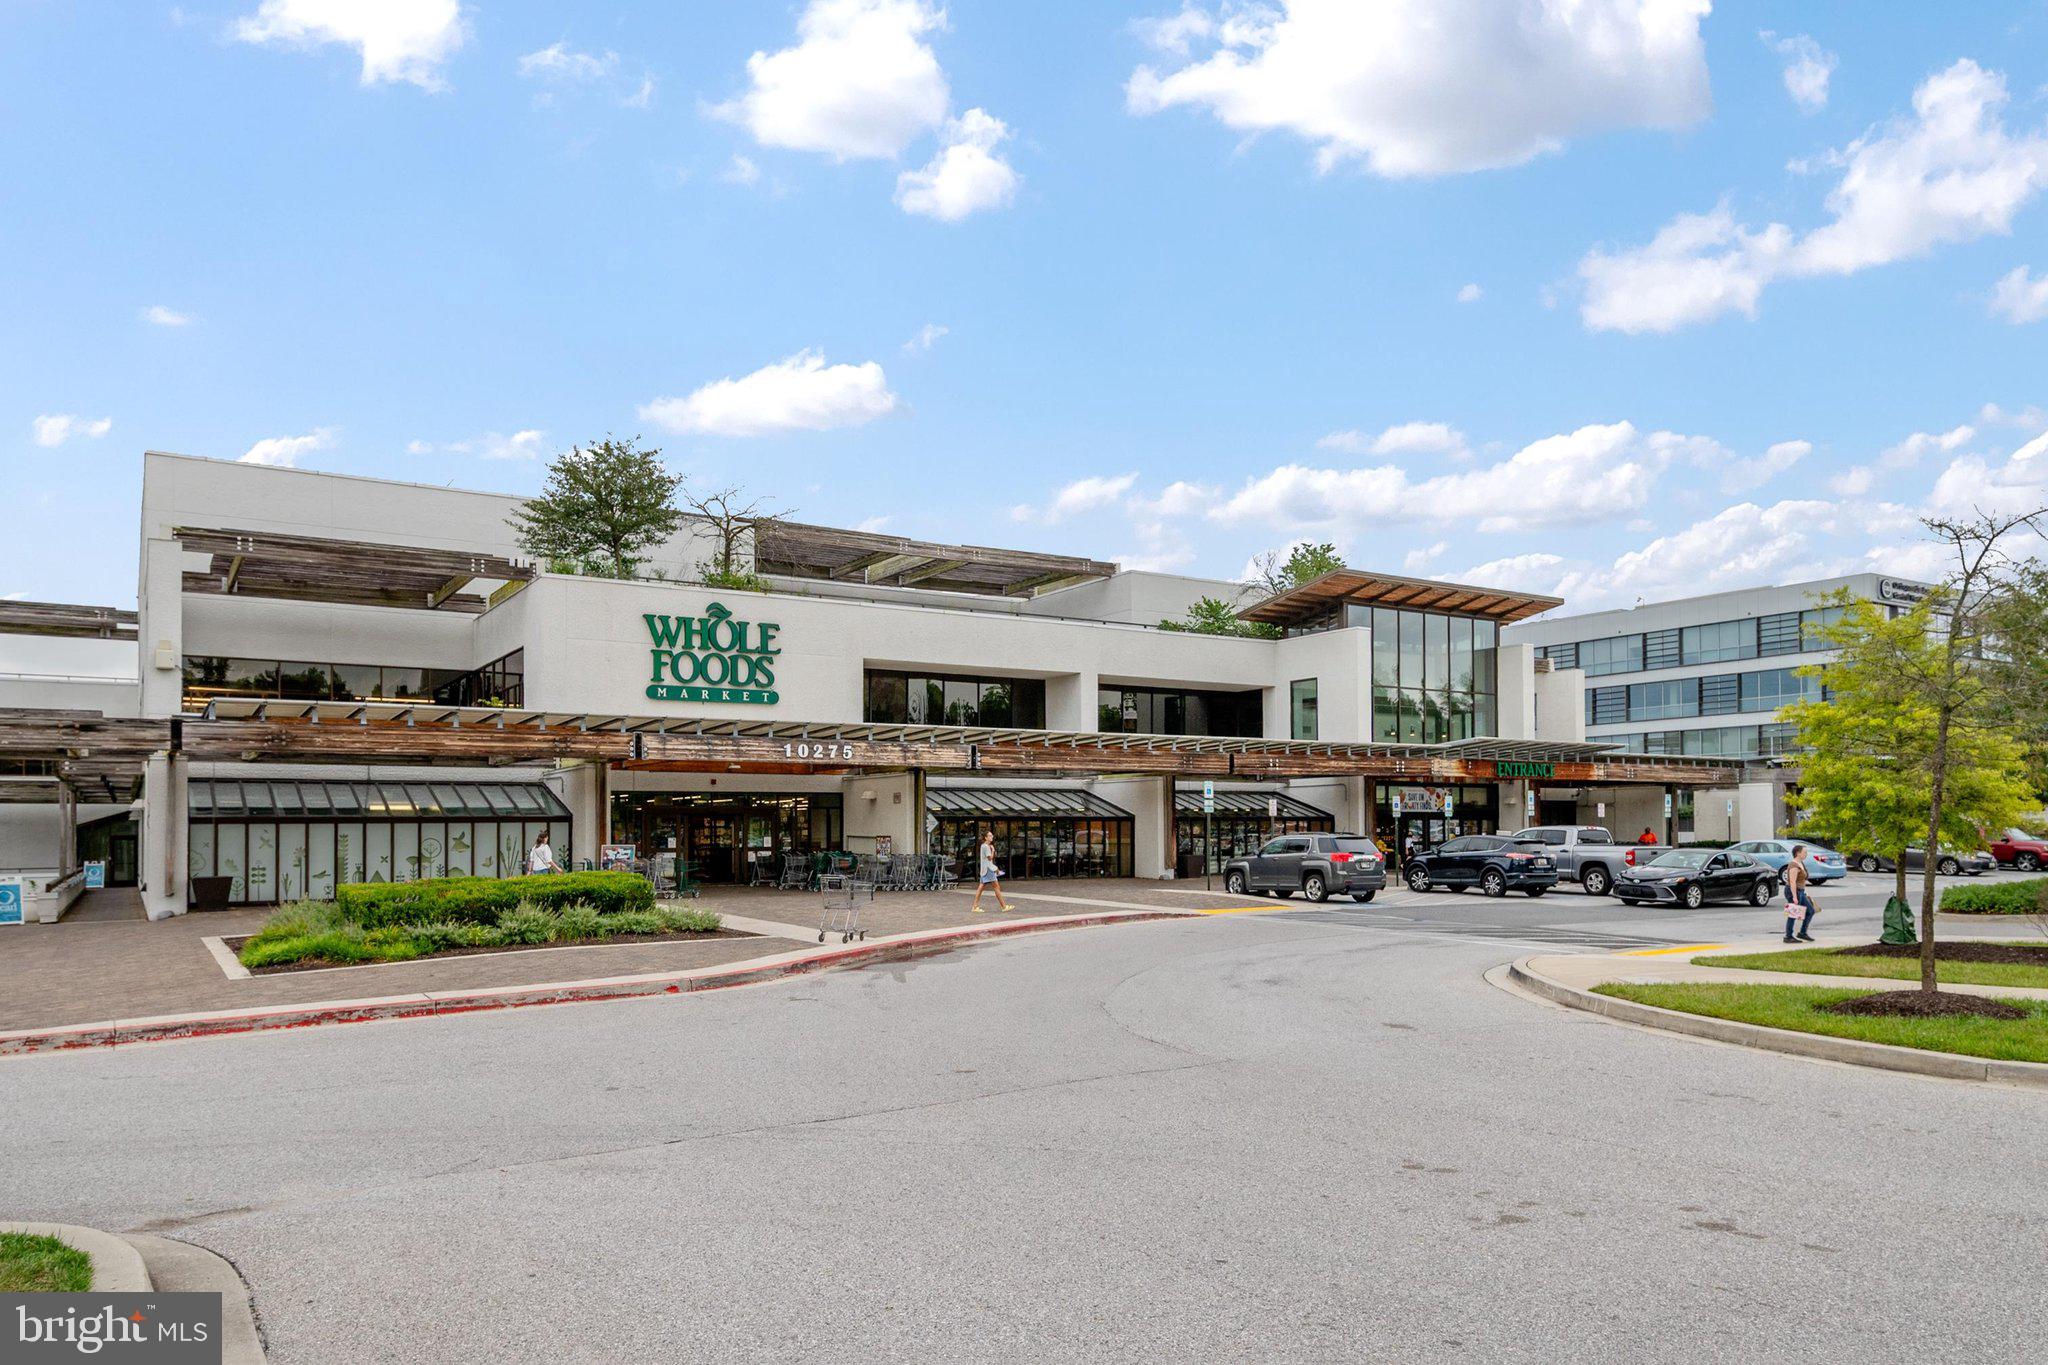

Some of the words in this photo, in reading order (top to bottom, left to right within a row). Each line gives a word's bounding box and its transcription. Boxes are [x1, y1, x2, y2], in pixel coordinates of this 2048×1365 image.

[642, 612, 782, 655] WHOLE
[650, 649, 775, 688] FOODS
[656, 687, 770, 702] MARKET
[783, 743, 853, 759] 10275
[1497, 761, 1555, 778] ENTRANCE
